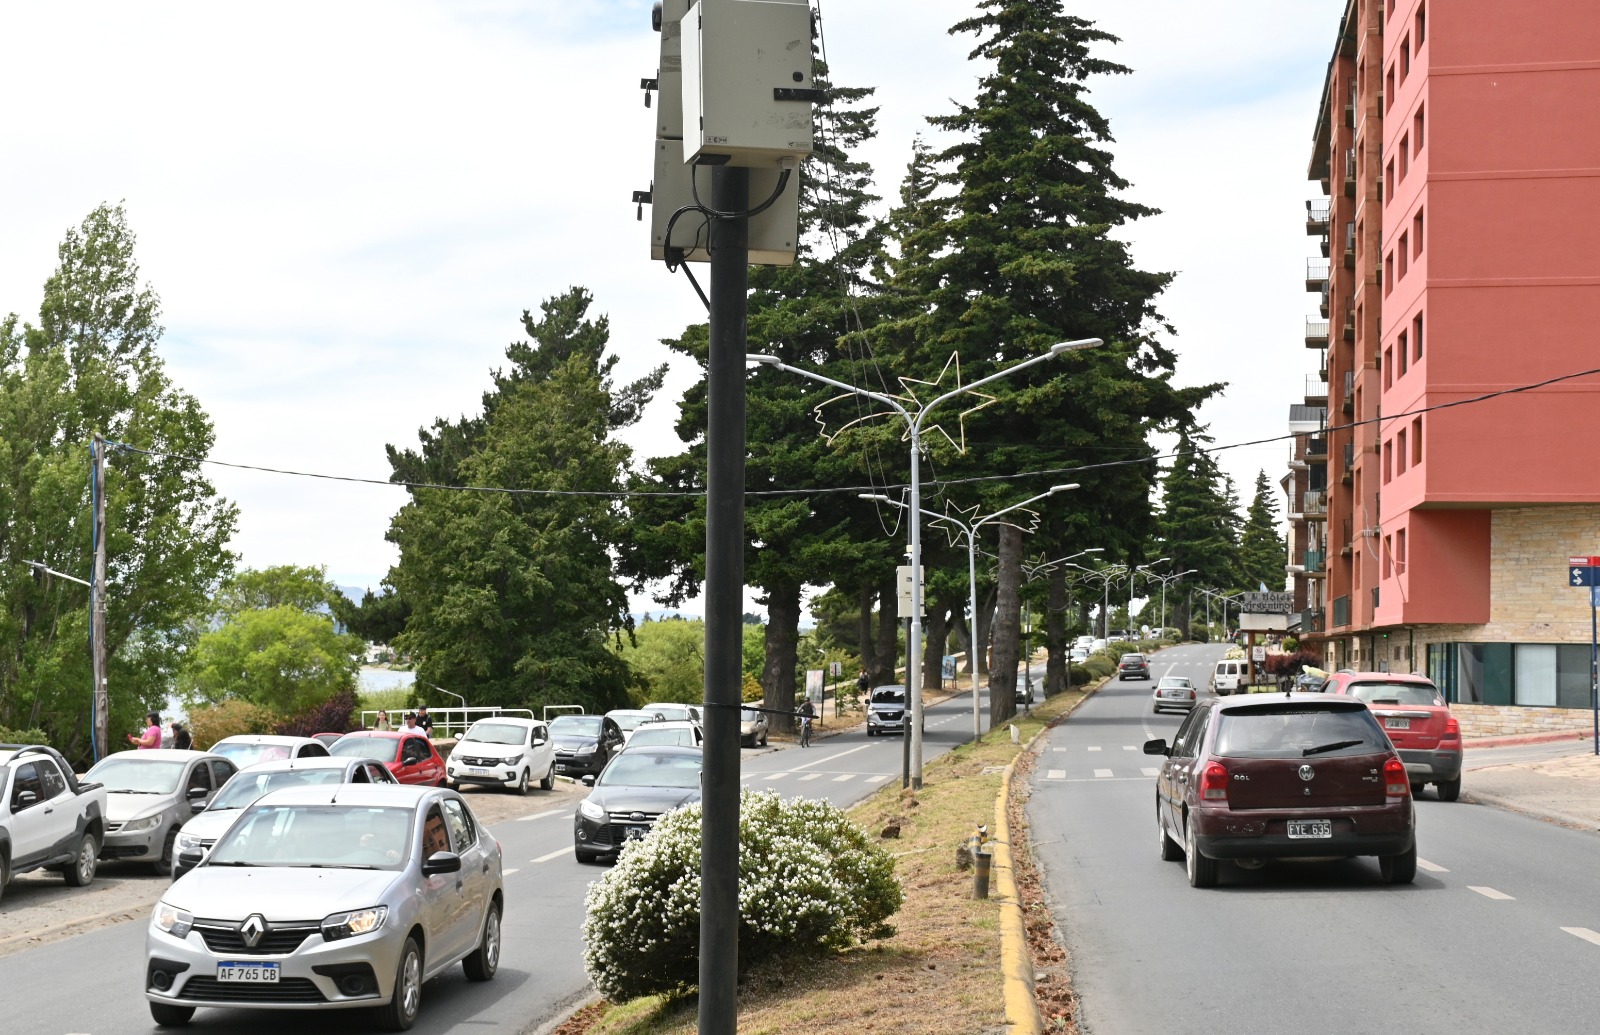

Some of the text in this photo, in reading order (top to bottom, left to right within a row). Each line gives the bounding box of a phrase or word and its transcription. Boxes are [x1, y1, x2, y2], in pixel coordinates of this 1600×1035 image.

[1289, 824, 1330, 835] FYE 635
[220, 968, 277, 981] AF 765 CB
